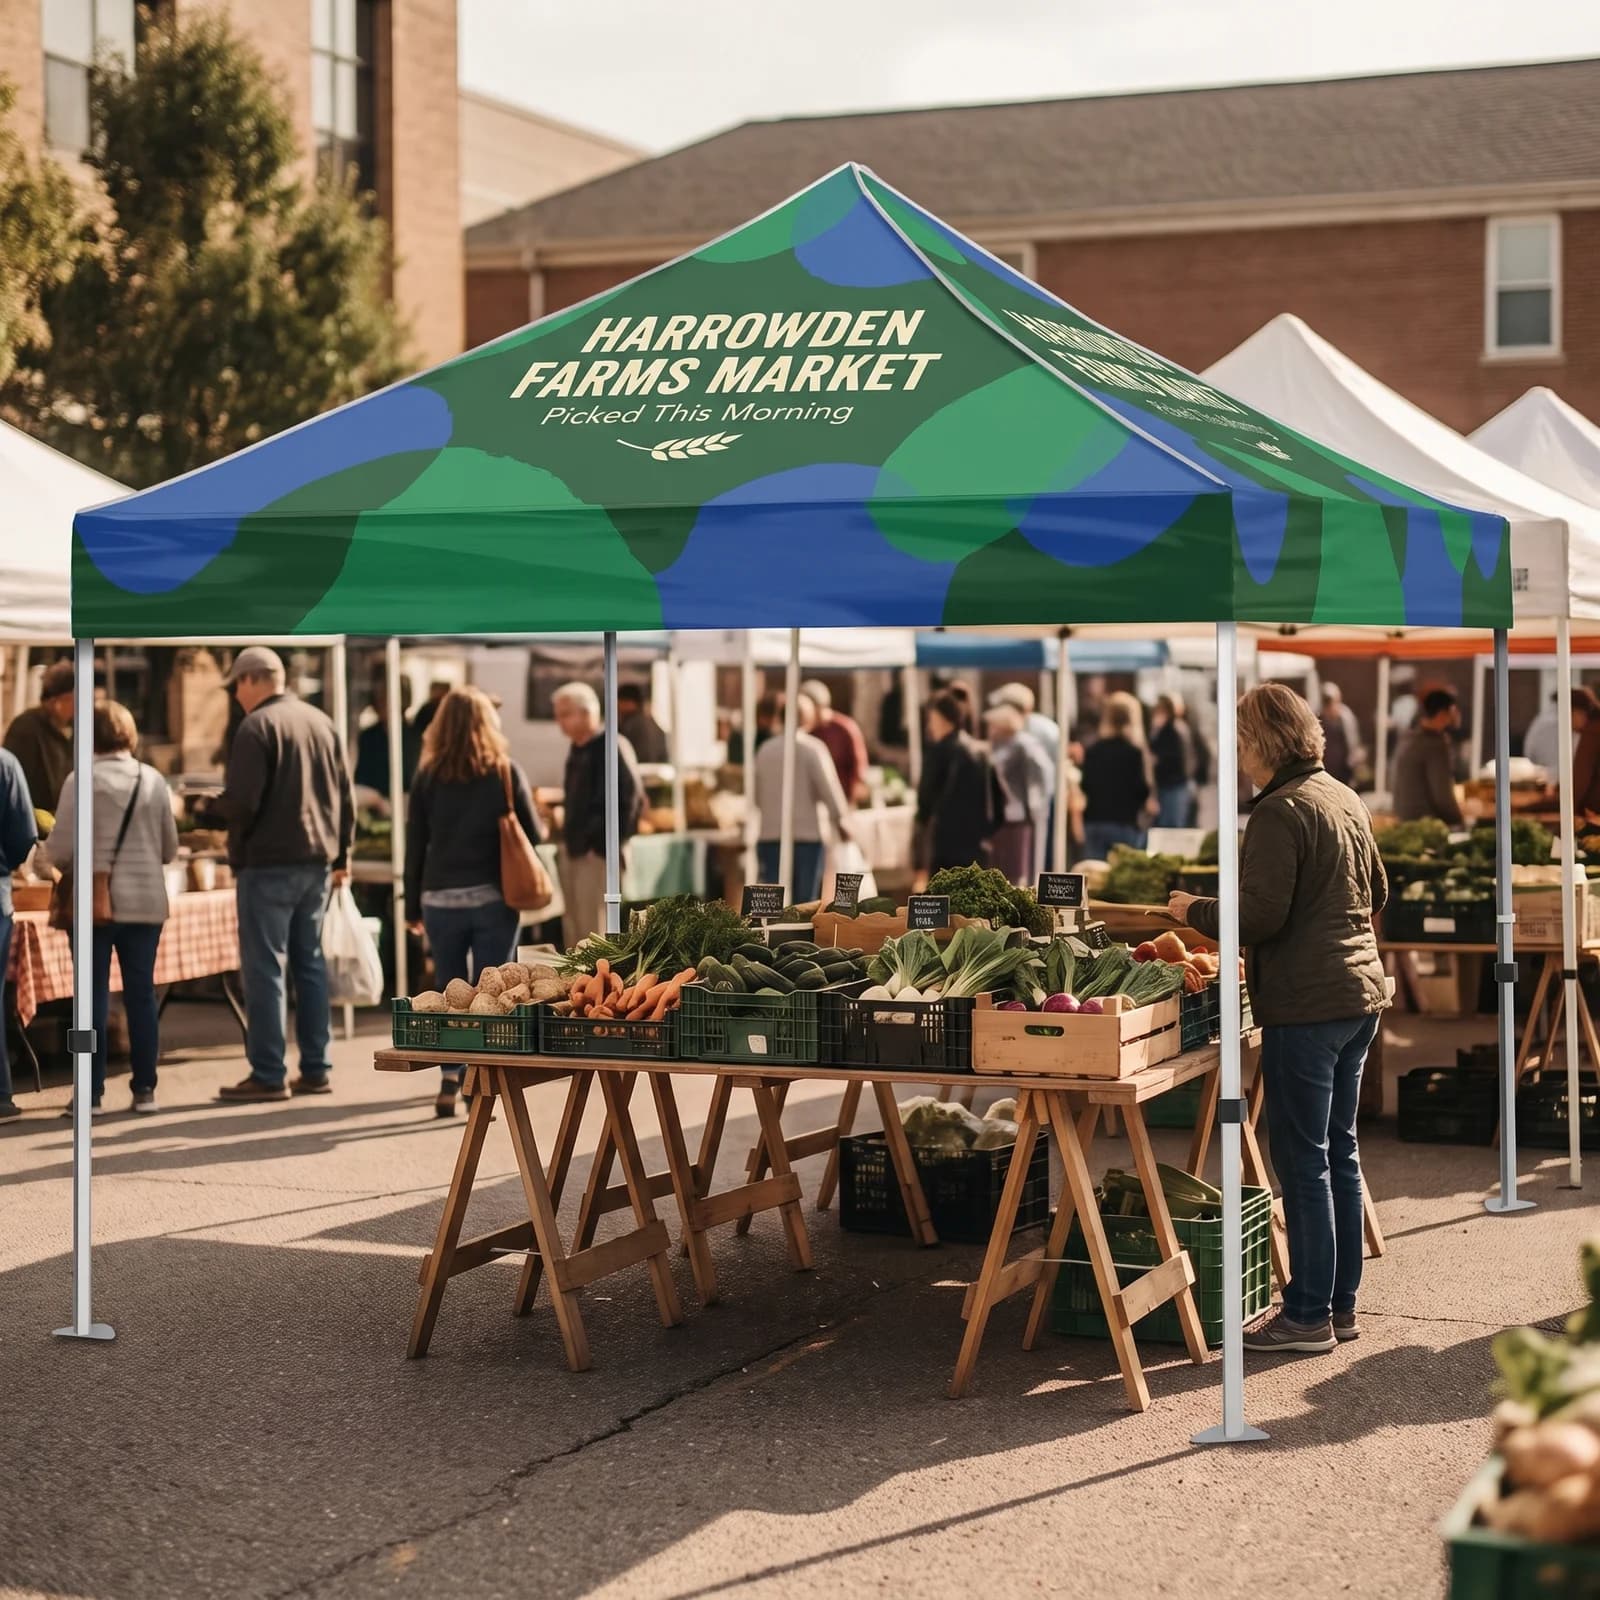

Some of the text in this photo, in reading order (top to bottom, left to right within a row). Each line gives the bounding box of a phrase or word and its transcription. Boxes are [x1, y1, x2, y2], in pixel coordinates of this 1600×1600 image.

[581, 309, 926, 353] HARROWDEN
[510, 352, 943, 399] FARMS MARKET
[540, 403, 855, 426] Picked This Morning
